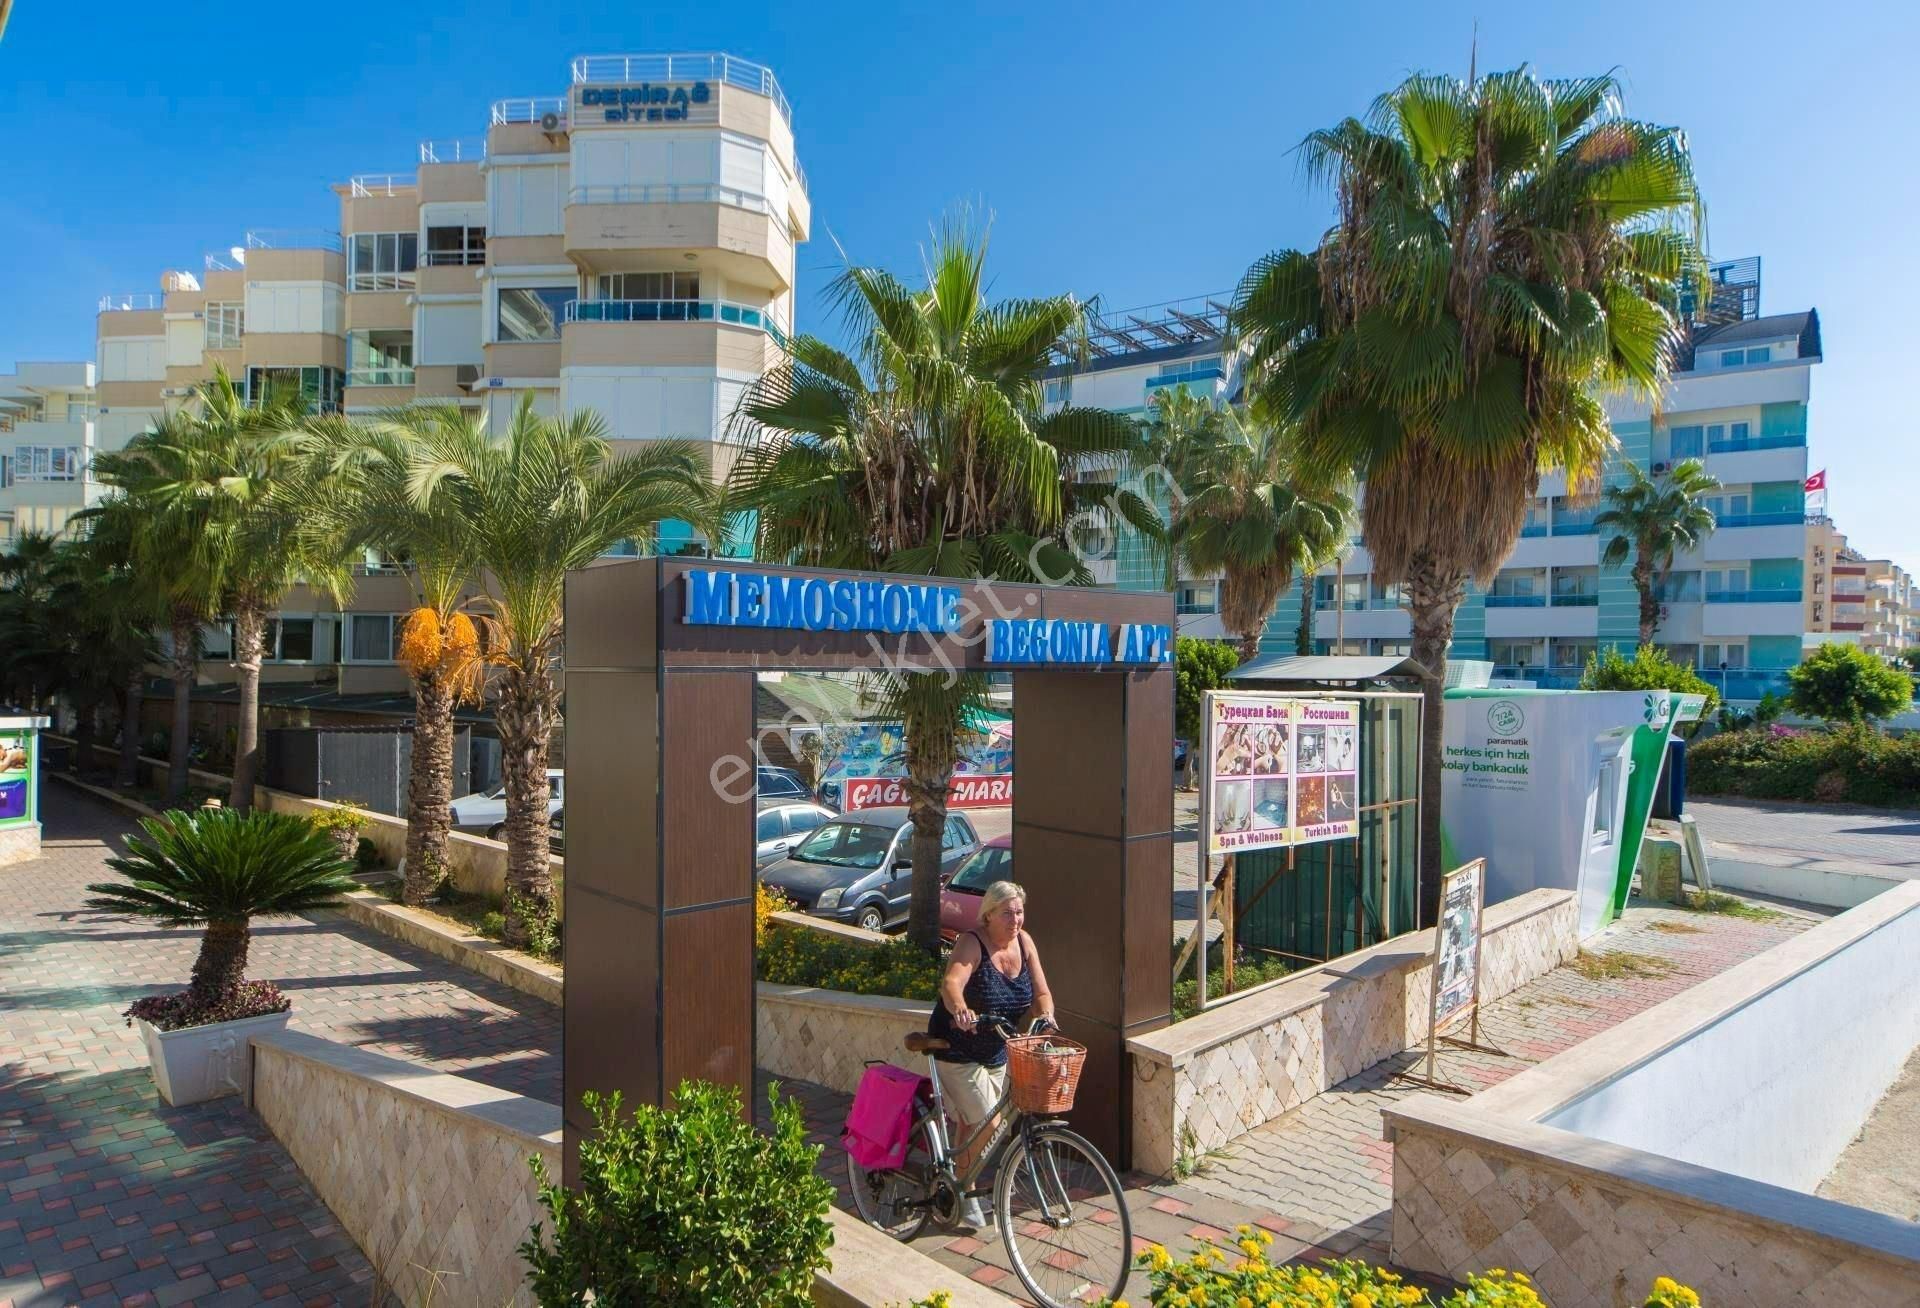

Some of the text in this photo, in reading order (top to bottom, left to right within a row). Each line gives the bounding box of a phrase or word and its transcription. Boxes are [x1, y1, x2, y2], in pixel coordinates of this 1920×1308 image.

[582, 82, 710, 106] DEMİRAĞ
[682, 570, 961, 633] MEMOSHOME
[984, 619, 1172, 663] BEGONIA APT.
[1217, 704, 1289, 720] Турецкая Баня
[1303, 706, 1350, 720] Роскошная
[1487, 738, 1529, 746] paramatik
[1446, 746, 1530, 760] herkes için hızlı
[1441, 760, 1529, 775] kolay bankacılık
[1304, 823, 1349, 838] Turkish Bath
[1220, 832, 1283, 848] Spa & Wellness
[980, 1118, 1008, 1160] SALCANO
